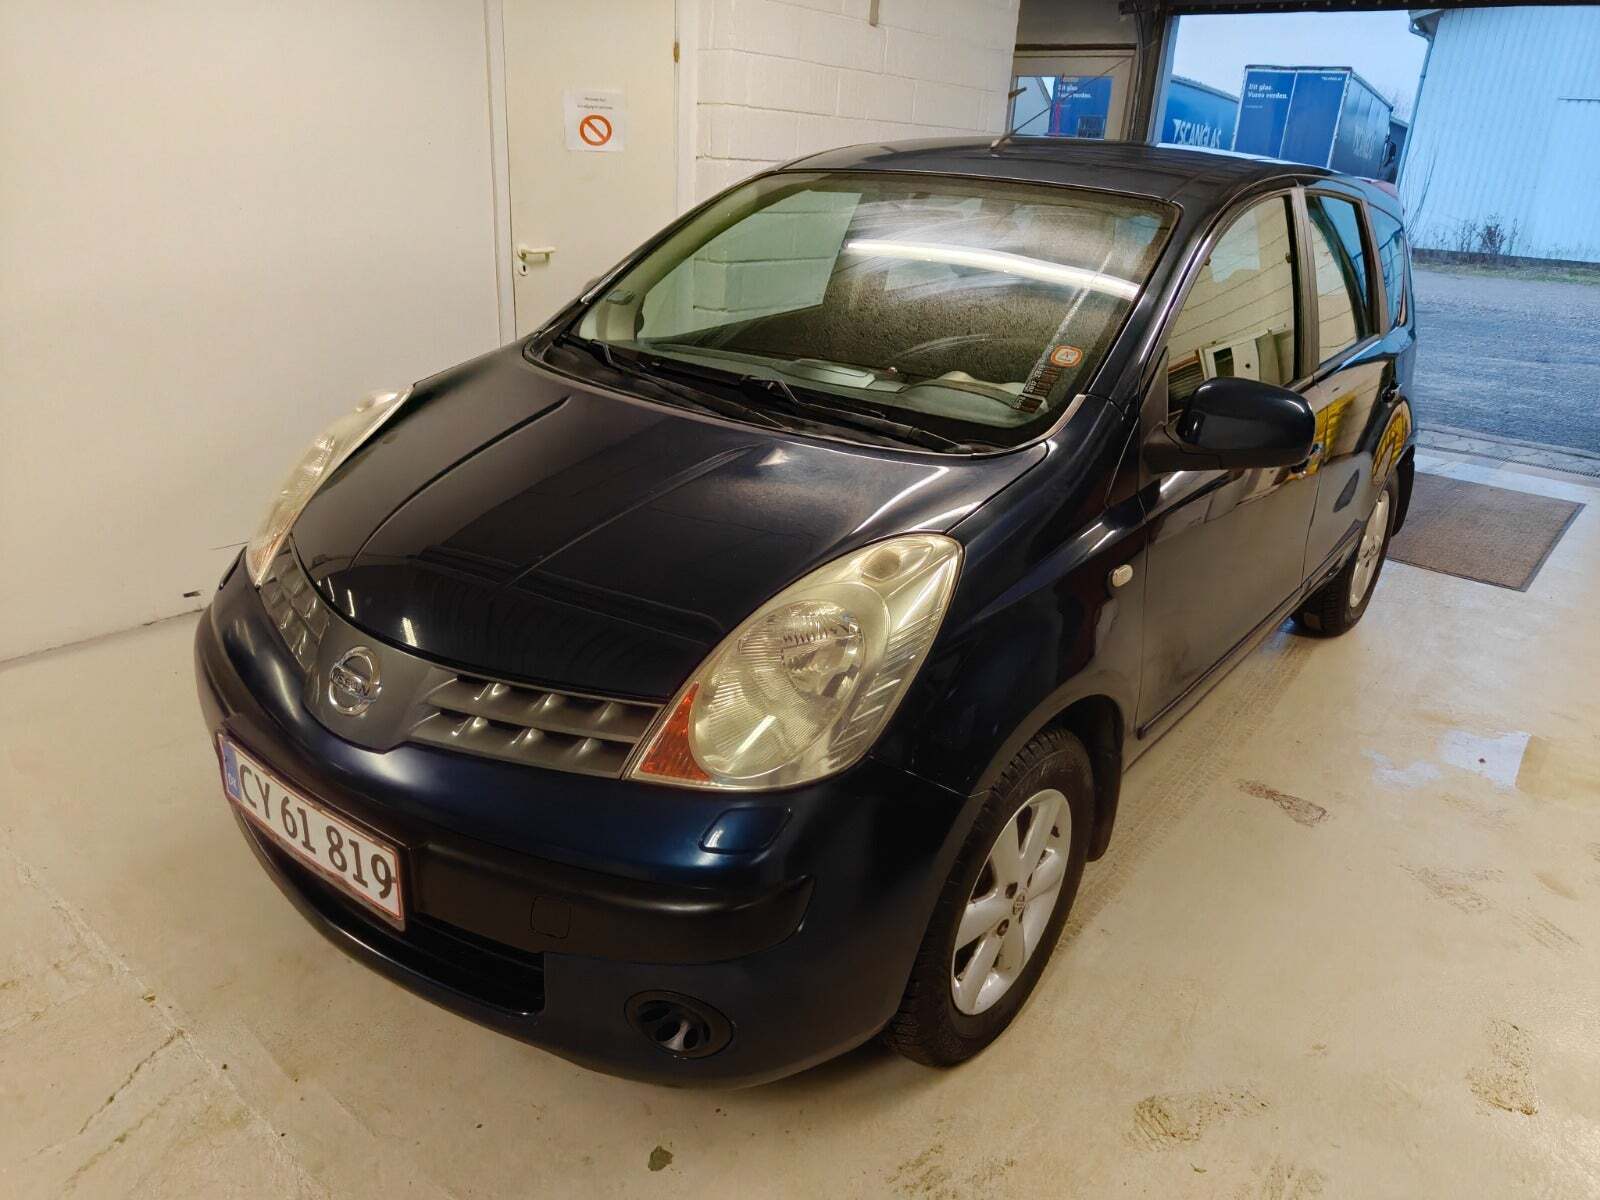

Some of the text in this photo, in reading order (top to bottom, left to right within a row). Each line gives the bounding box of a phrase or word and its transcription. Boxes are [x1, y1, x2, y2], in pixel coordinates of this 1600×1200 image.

[240, 764, 393, 899] CY 61 819
